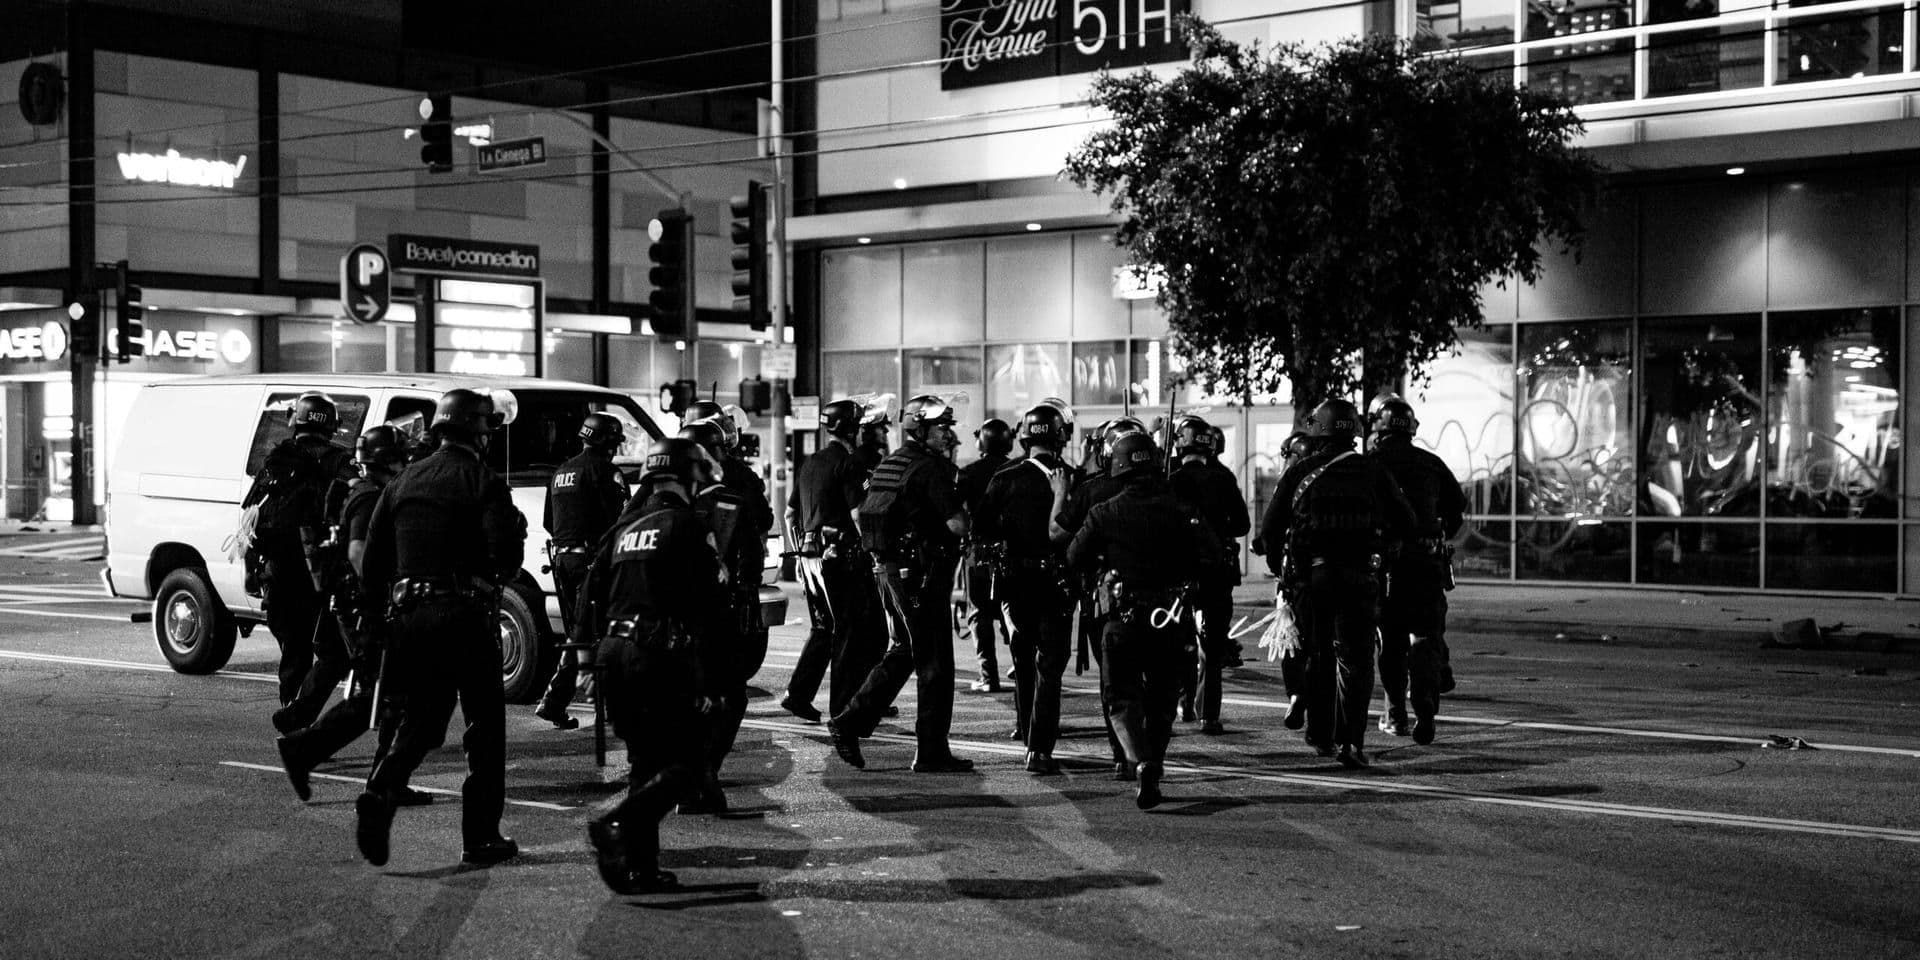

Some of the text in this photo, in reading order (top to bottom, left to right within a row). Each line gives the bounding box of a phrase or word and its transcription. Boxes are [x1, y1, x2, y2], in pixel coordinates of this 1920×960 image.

[948, 18, 1048, 71] Avenue
[359, 252, 385, 286] P
[1029, 423, 1049, 435] 40847
[554, 472, 577, 488] POLICE
[617, 528, 661, 553] POLICE
